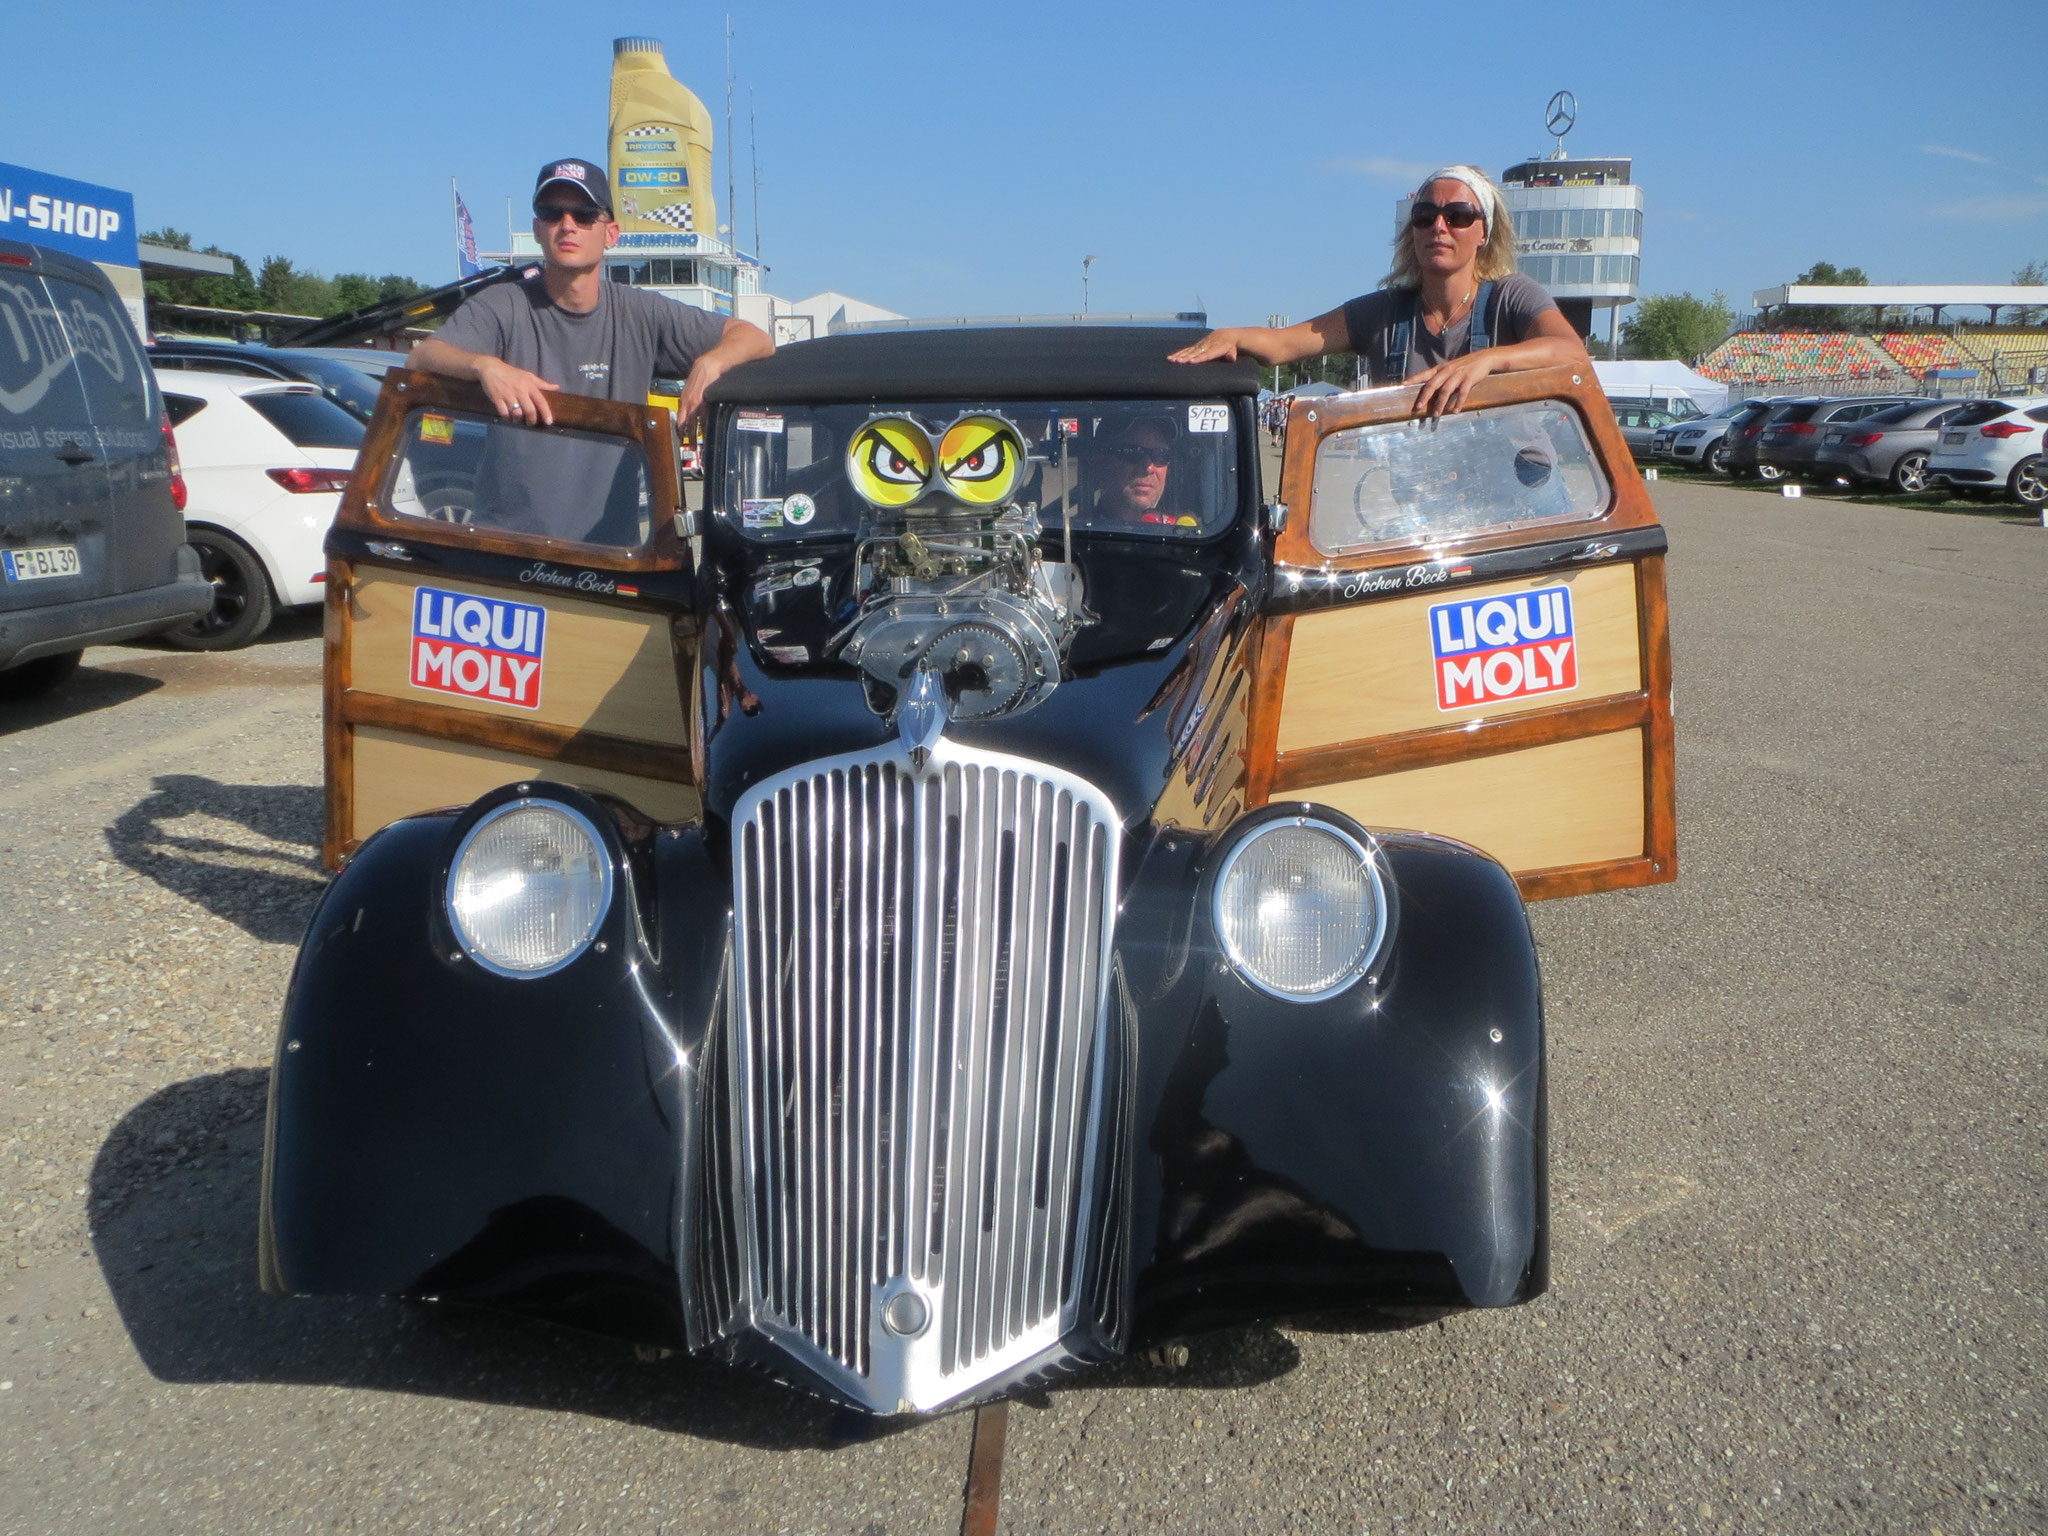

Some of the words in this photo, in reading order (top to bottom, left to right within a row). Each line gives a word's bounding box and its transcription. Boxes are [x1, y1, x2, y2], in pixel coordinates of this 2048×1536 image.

[1531, 239, 1566, 251] Center
[1190, 407, 1227, 420] S/Pro
[1200, 418, 1220, 431] ET
[0, 425, 41, 449] isual
[44, 428, 92, 449] stereo
[14, 553, 26, 577] F
[58, 549, 77, 572] 39
[520, 562, 573, 586] Jochen
[575, 571, 616, 594] Beck
[1344, 571, 1402, 599] Jochen
[1405, 565, 1448, 587] Beck
[420, 592, 539, 653] LIQUI
[1437, 592, 1567, 653] LIQUI
[417, 641, 540, 701] MOLY
[1442, 641, 1572, 705] MOLY
